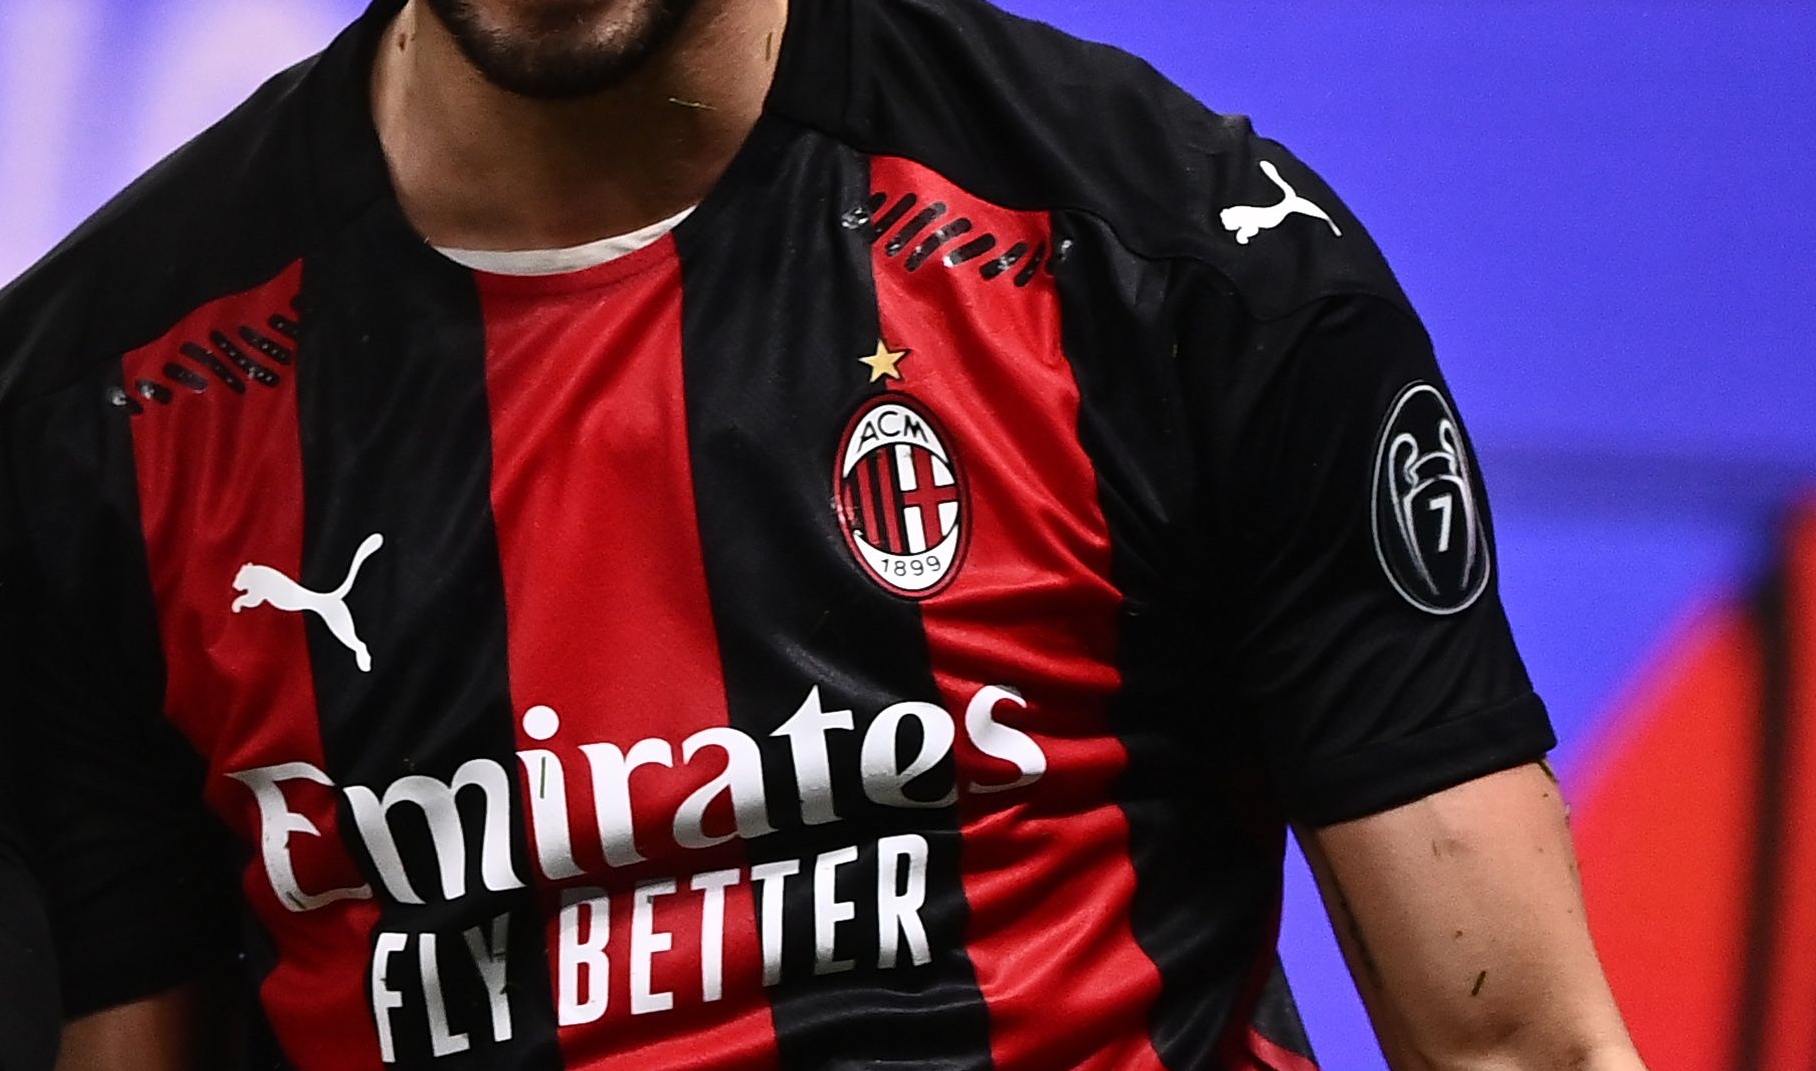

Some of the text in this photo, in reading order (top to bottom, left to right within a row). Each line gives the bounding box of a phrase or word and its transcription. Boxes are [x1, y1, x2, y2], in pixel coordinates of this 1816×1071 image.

[857, 411, 930, 453] ACM
[1427, 493, 1453, 552] 7
[881, 555, 942, 577] 1899
[224, 685, 1048, 912] Emirates
[371, 833, 931, 1063] FLY BETTER
